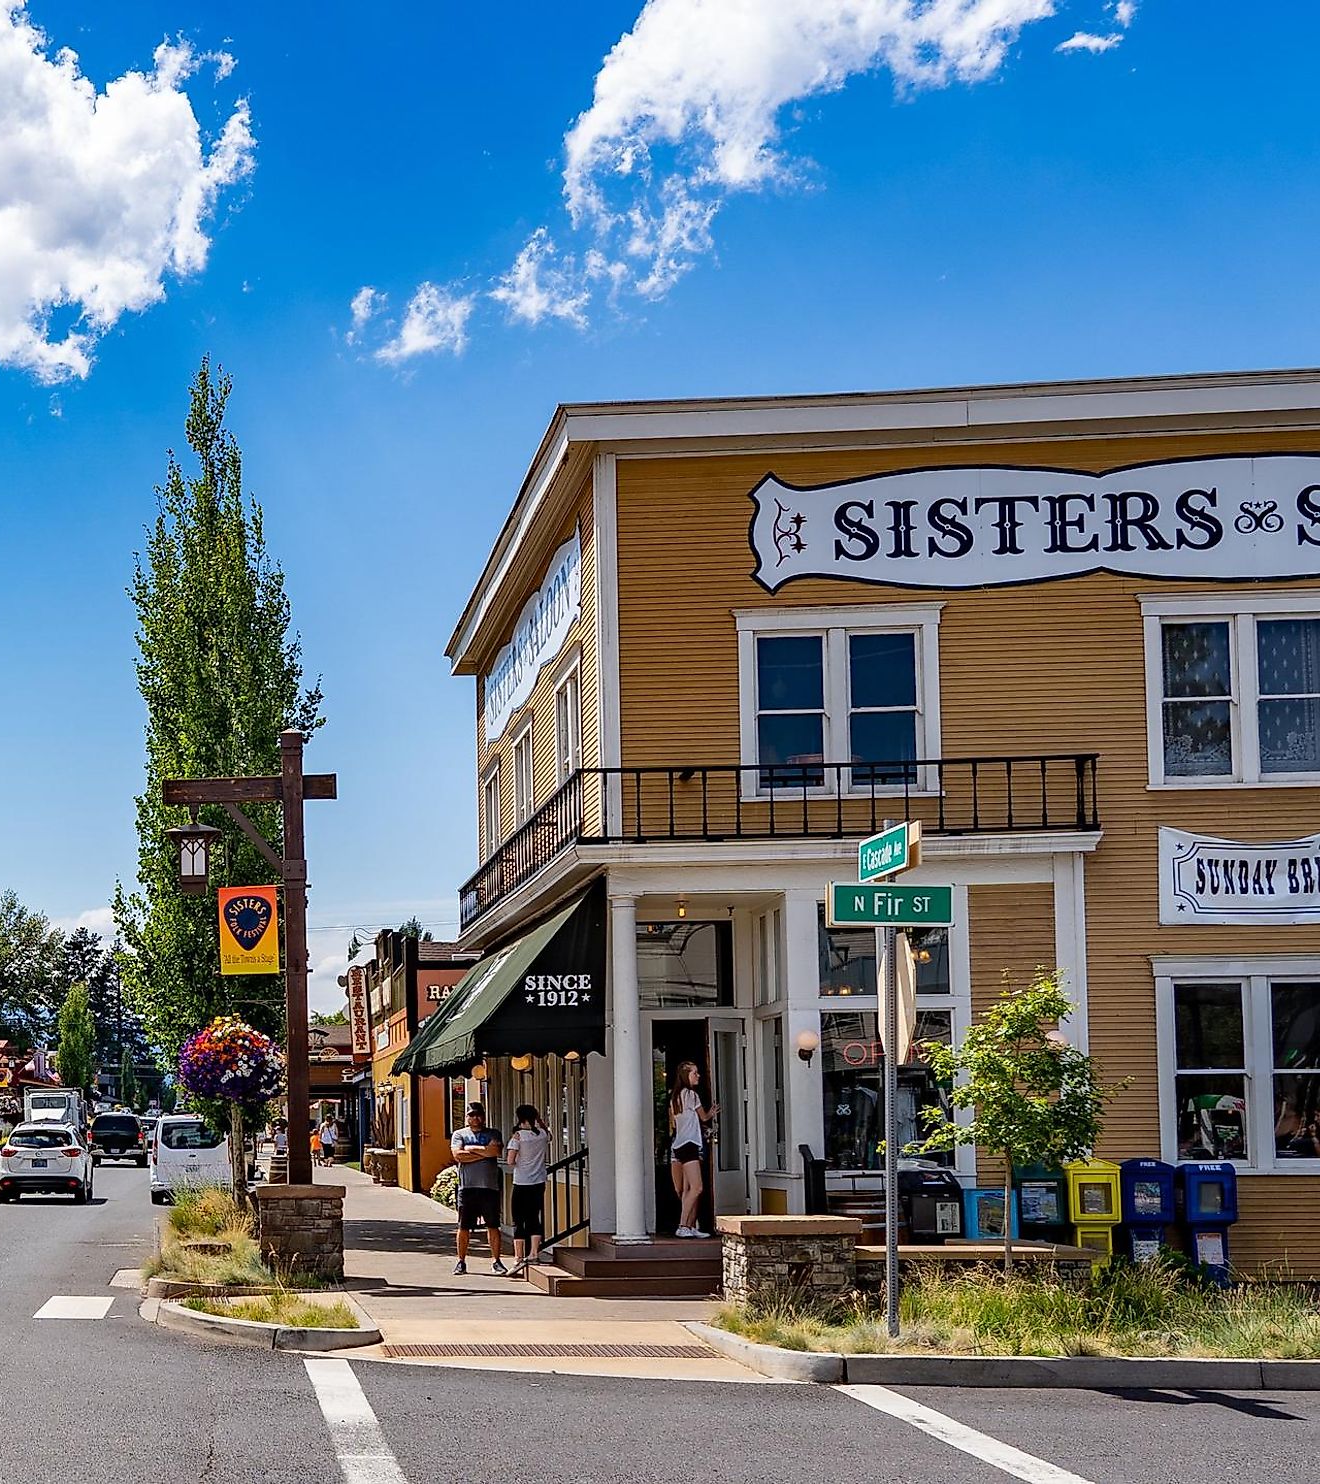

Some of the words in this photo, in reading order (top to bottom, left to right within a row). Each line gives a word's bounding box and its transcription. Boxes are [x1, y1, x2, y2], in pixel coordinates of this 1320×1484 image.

[833, 487, 1224, 561] SISTERS
[527, 554, 573, 667] SALOON
[862, 853, 867, 869] E
[867, 841, 893, 870] Cascade
[893, 840, 903, 857] Ave
[1195, 857, 1278, 895] SUNDAY
[228, 898, 267, 916] SISTERS
[854, 895, 865, 912] N
[873, 892, 904, 916] Fir
[912, 896, 932, 913] ST
[243, 916, 267, 939] FESTIVAL
[524, 974, 592, 991] SINCE
[350, 969, 368, 1051] RESTAURANT
[537, 990, 579, 1007] 1912
